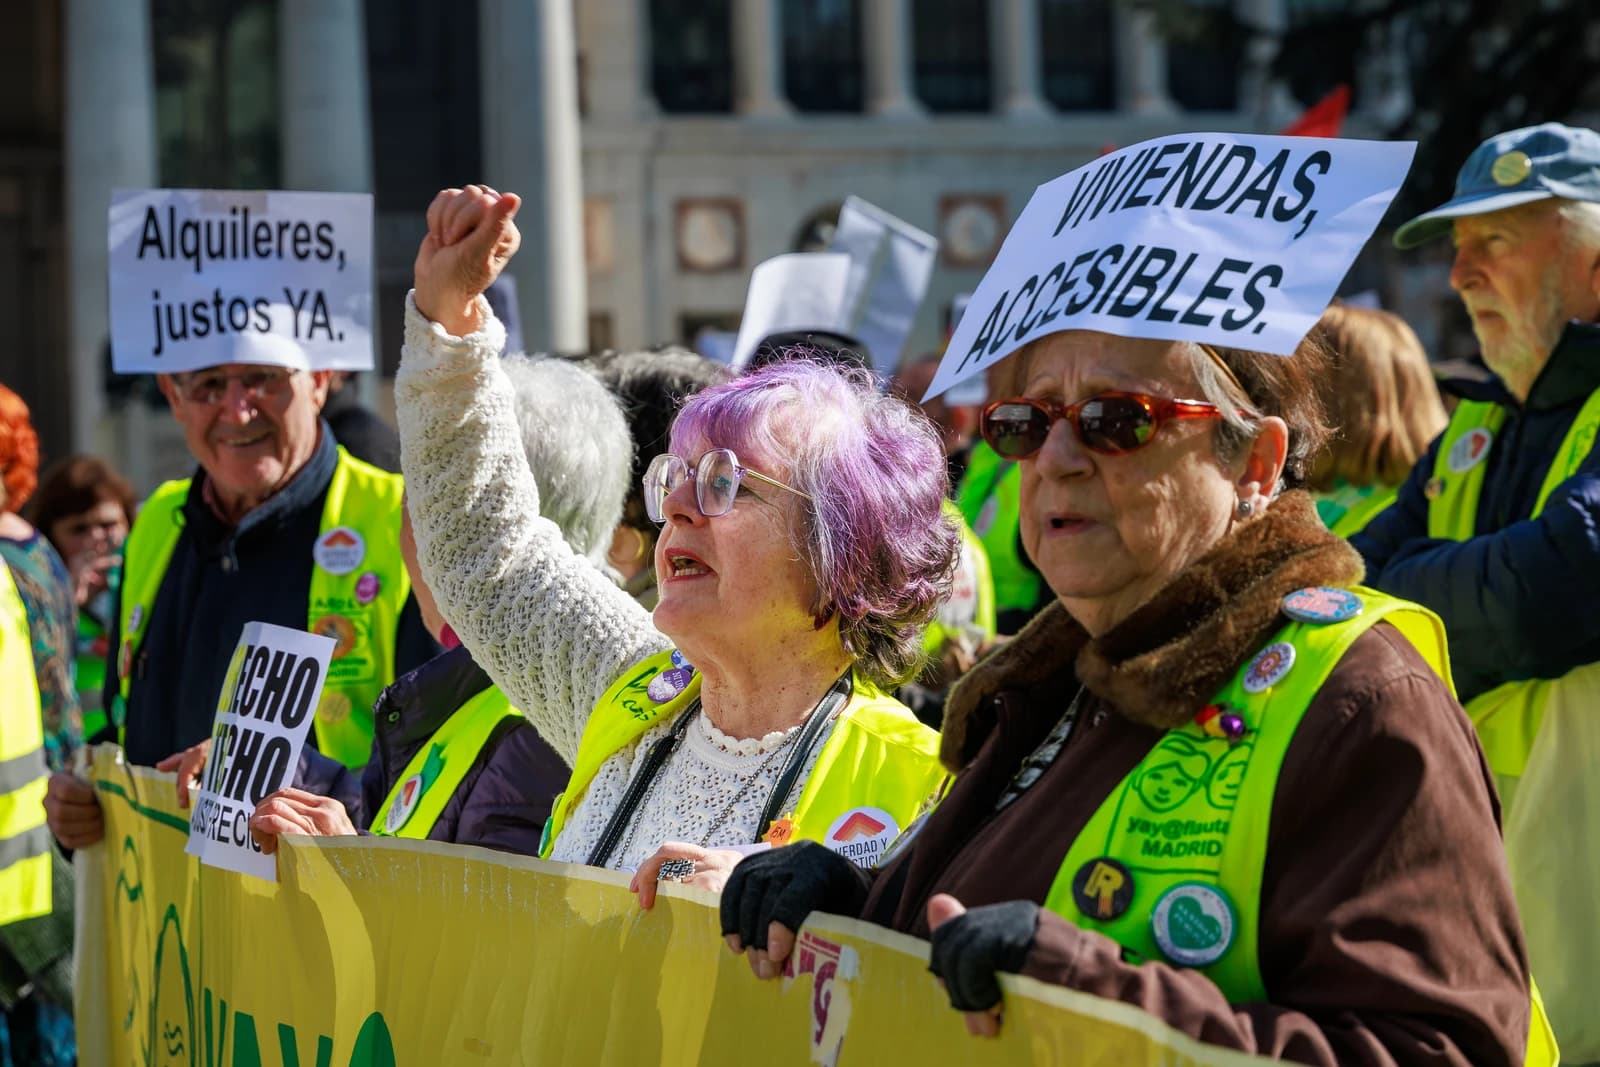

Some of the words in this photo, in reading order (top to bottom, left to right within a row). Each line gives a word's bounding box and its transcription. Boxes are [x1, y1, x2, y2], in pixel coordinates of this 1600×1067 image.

[1053, 142, 1331, 240] VIVIENDAS,
[137, 205, 346, 273] Alquileres,
[153, 288, 271, 356] justos
[284, 287, 344, 341] YA.
[956, 243, 1284, 374] ACCESIBLES.
[1141, 838, 1224, 858] MADRID
